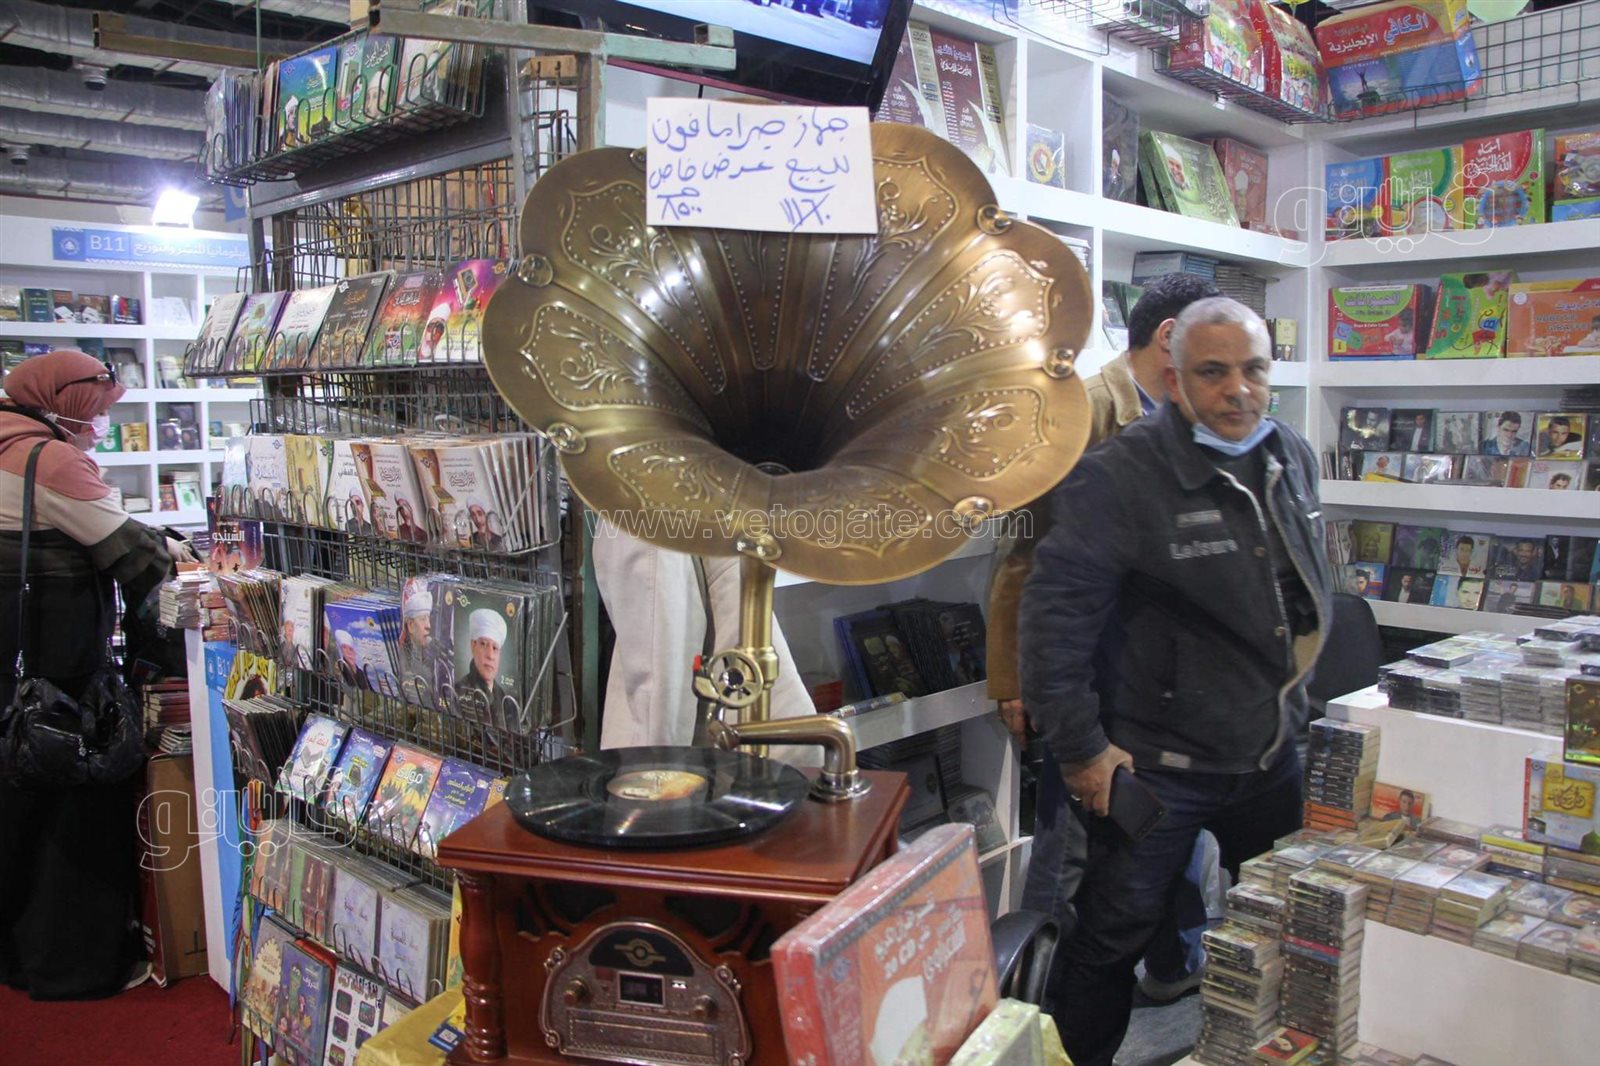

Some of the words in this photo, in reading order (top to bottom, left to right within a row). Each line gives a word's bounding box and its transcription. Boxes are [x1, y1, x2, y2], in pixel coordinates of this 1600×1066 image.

[1384, 12, 1429, 45] الكافي
[794, 106, 849, 147] جهاز
[649, 157, 697, 189] خاص
[702, 152, 774, 180] عرض
[785, 155, 850, 193] للبيع
[90, 235, 125, 252] B11
